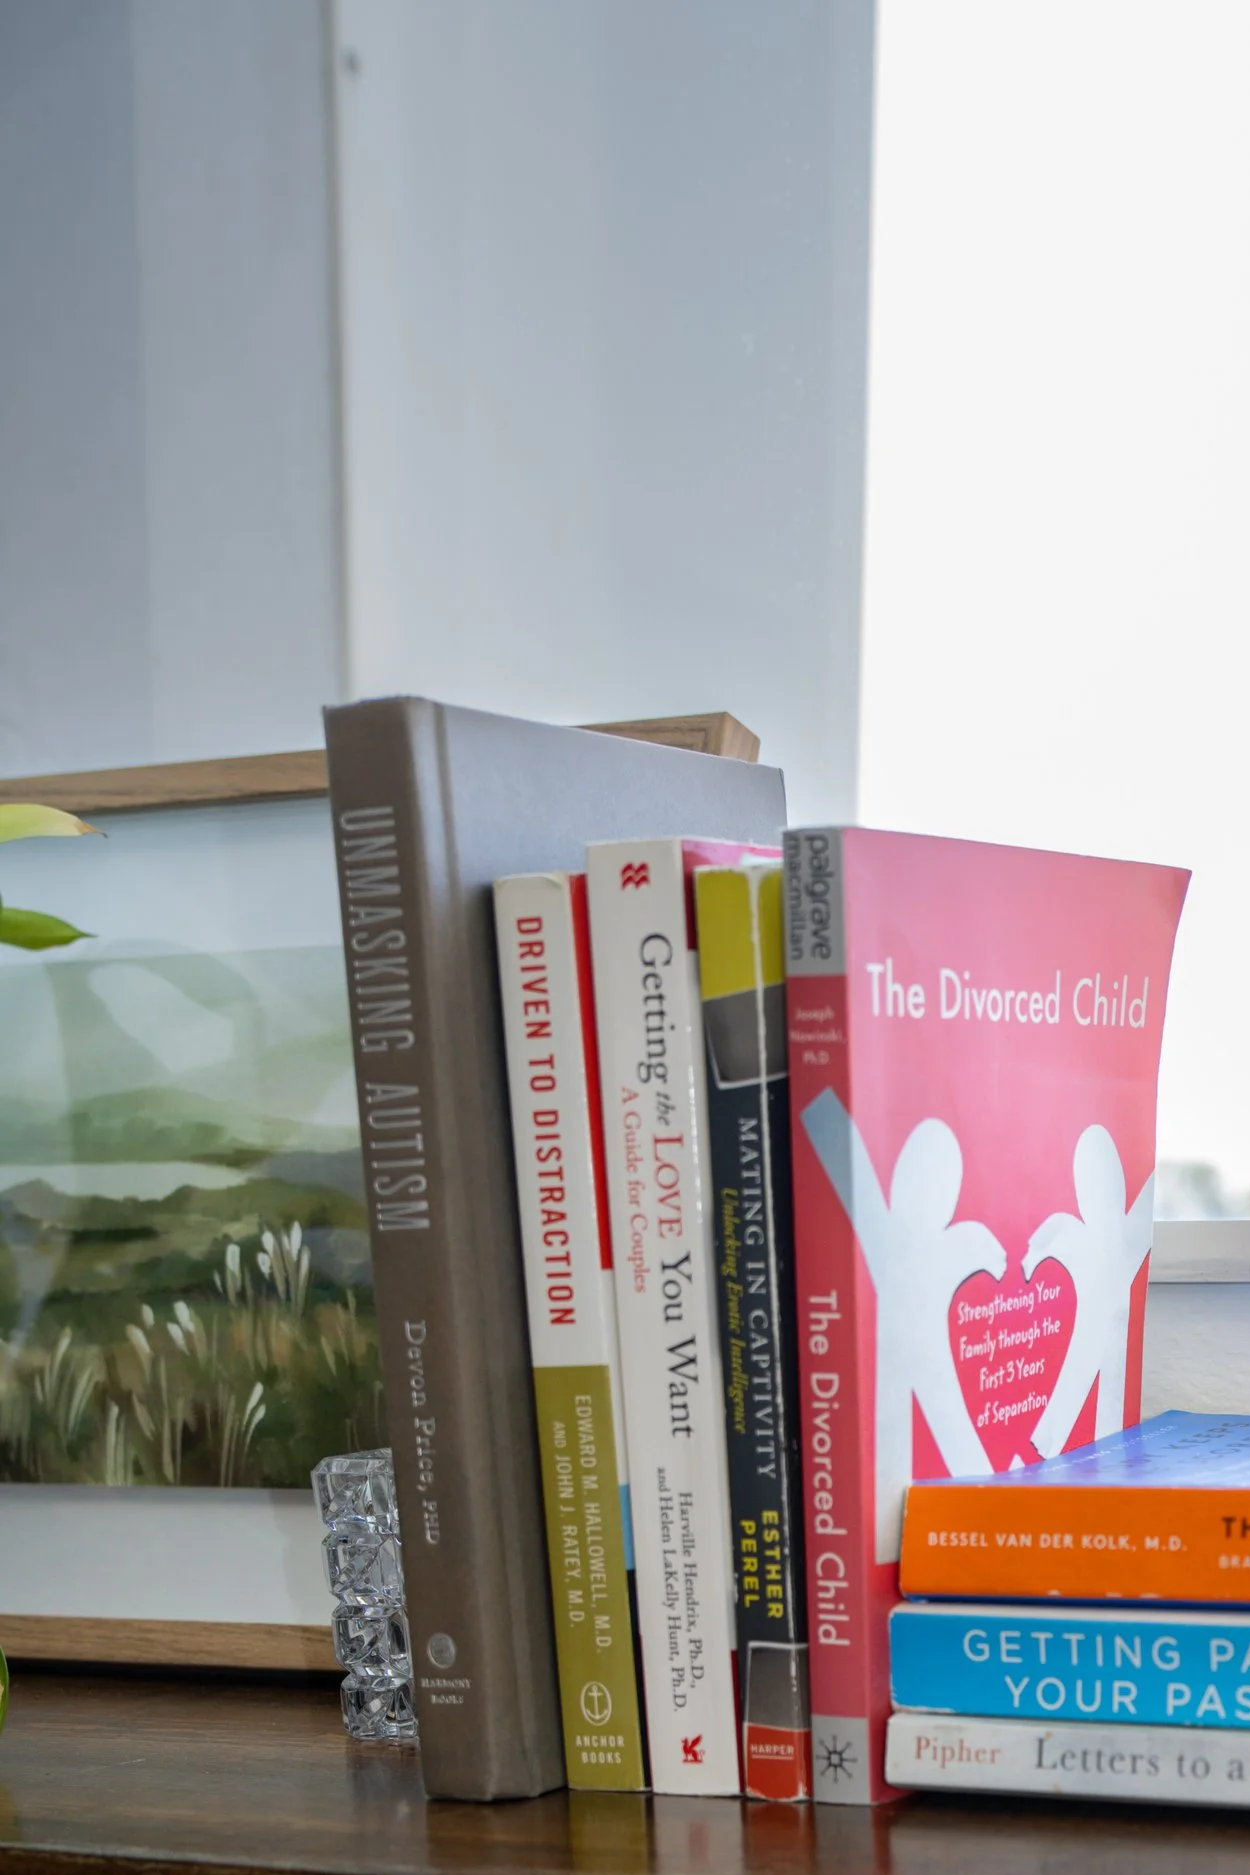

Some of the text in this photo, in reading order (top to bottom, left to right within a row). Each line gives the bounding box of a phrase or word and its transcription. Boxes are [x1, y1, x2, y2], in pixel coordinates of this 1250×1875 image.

[786, 834, 807, 961] macmillan
[805, 834, 834, 961] palgrave
[339, 806, 430, 1231] UNMASKING AUTISM
[866, 958, 1148, 1029] The Divorced Child
[516, 916, 576, 1326] DRIVEN TO DISTRACTION
[622, 1086, 651, 1293] A Guide for Couples
[638, 932, 699, 1438] Getting the LOVE You Want
[721, 1187, 739, 1278] Unlocking
[738, 1117, 778, 1480] MATING IN CAPTIVITY
[957, 1281, 1061, 1326] Strengthening Your
[959, 1317, 1061, 1361] Family through the
[729, 1340, 749, 1435] Intelligence
[977, 1392, 1048, 1428] of Separation
[979, 1358, 1046, 1393] First 3 Years
[404, 1319, 441, 1546] Devon Price, PHD
[808, 1291, 851, 1646] The Divorced Child
[553, 1421, 586, 1629] AND JOHN J. RATEY, M.D.
[575, 1394, 613, 1653] EDWARD M. HALLOWELL, M.D.
[679, 1492, 696, 1557] Harville
[740, 1520, 760, 1608] PEREL
[762, 1510, 784, 1619] ESTHER
[928, 1531, 1187, 1552] BESSEL VAN DER KOLK, M.D.
[657, 1467, 688, 1712] and Helen LaKelly Hunt, Ph.D.
[684, 1563, 700, 1633] Hendrix,
[962, 1629, 1182, 1671] GETTING
[1004, 1674, 1137, 1715] YOUR
[576, 1735, 625, 1747] ANCHOR
[581, 1752, 622, 1764] BOOKS
[750, 1744, 795, 1756] HARPER
[915, 1736, 1001, 1768] Pipher
[1036, 1738, 1161, 1777] Letters
[1176, 1746, 1211, 1780] to
[1227, 1758, 1246, 1781] a
